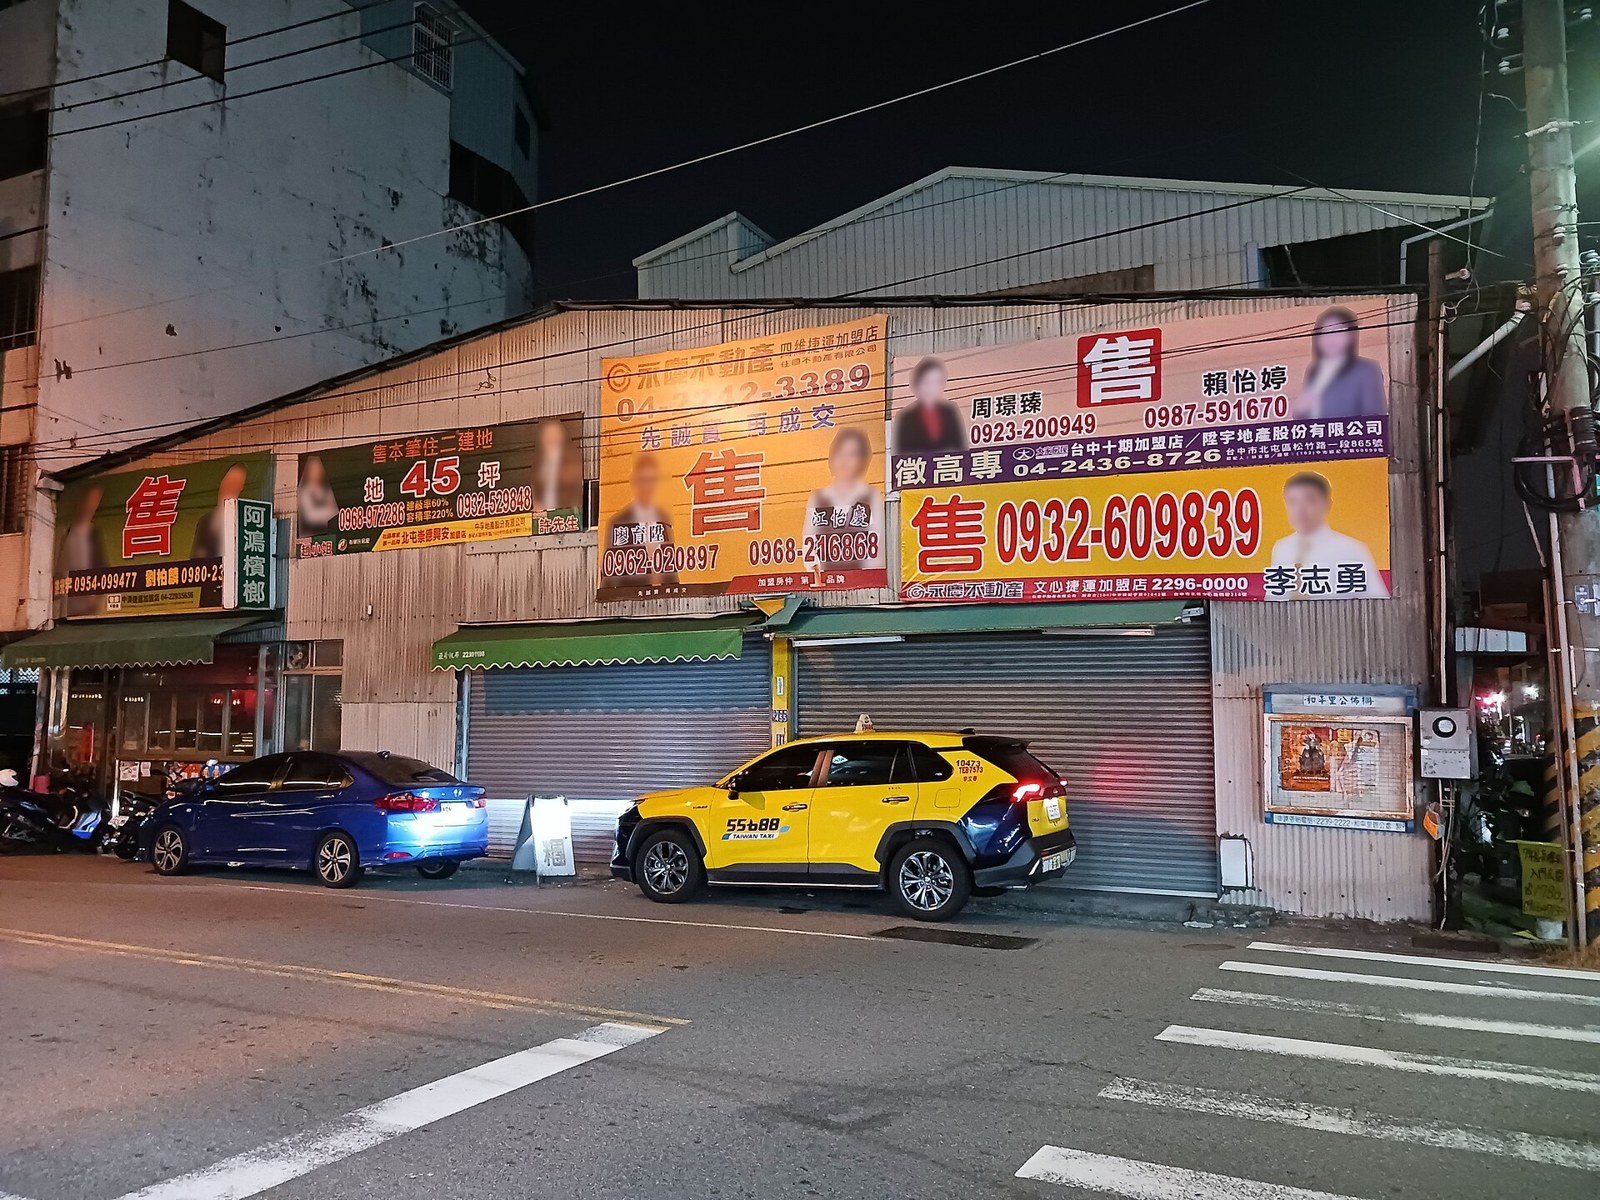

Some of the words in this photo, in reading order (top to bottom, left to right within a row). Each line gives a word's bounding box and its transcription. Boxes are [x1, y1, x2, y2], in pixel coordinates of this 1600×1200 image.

[1082, 335, 1157, 405] 售
[1202, 364, 1288, 397] 賴怡婷
[1143, 395, 1289, 429] 0987-591670
[969, 413, 1097, 446] 0923-200949
[364, 476, 384, 503] 地
[400, 456, 461, 498] 45
[478, 461, 500, 489] 坪
[894, 451, 1004, 487] 徵高專
[1013, 448, 1222, 478] 04-2436-8726
[457, 485, 532, 519] 0932-529848
[683, 449, 766, 538] 售
[122, 474, 187, 559] 售
[339, 501, 406, 532] 0968-972286
[538, 515, 579, 535] 許先生
[995, 486, 1261, 566] 0932-609839
[749, 532, 880, 567] 0968-216868
[910, 493, 987, 576] 售
[242, 504, 266, 605] 阿鴻檳榔
[602, 544, 719, 577] 0962-020897
[74, 571, 138, 592] 0954-099477
[928, 581, 1024, 598] 永慶不動產
[1033, 578, 1147, 594] 文心捷運加盟店
[1151, 577, 1248, 591] 2296-0000
[1264, 562, 1369, 597] 李志勇
[726, 818, 781, 832] 55688
